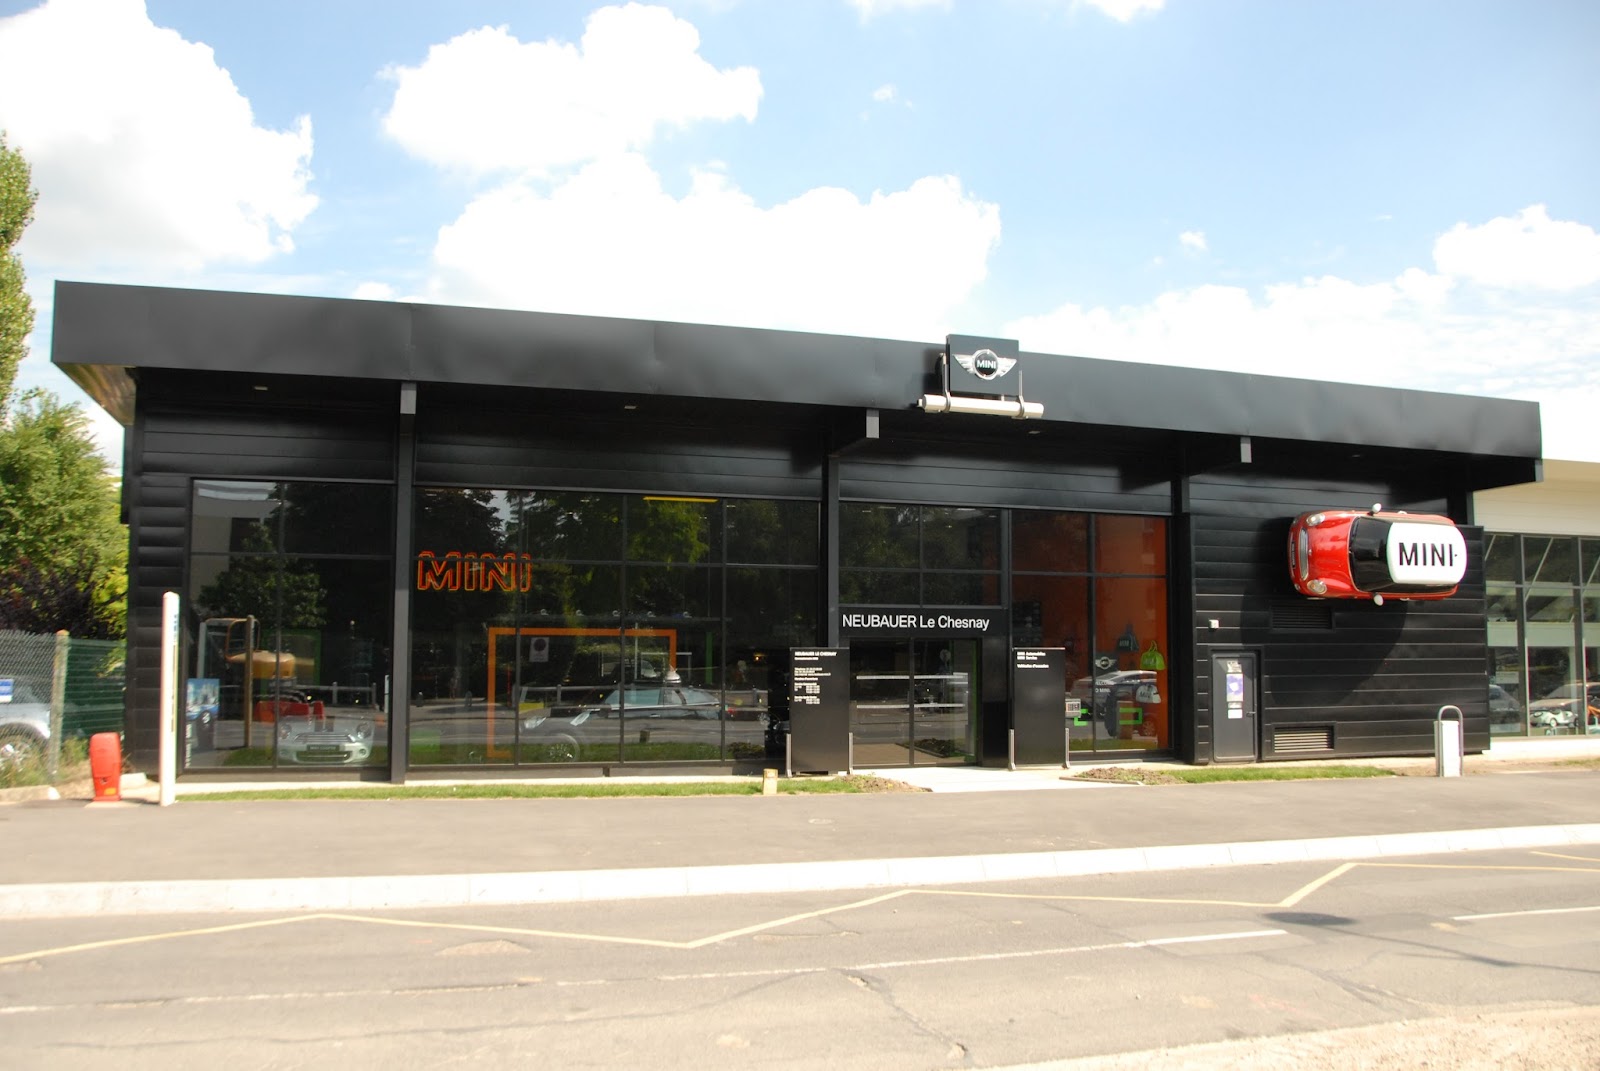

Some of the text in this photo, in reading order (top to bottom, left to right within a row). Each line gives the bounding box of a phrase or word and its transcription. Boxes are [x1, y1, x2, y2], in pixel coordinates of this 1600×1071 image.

[976, 359, 996, 369] MINI
[1399, 542, 1453, 567] MINI
[417, 551, 531, 592] MINI
[842, 614, 990, 632] NEUBAUER Le Chesnay
